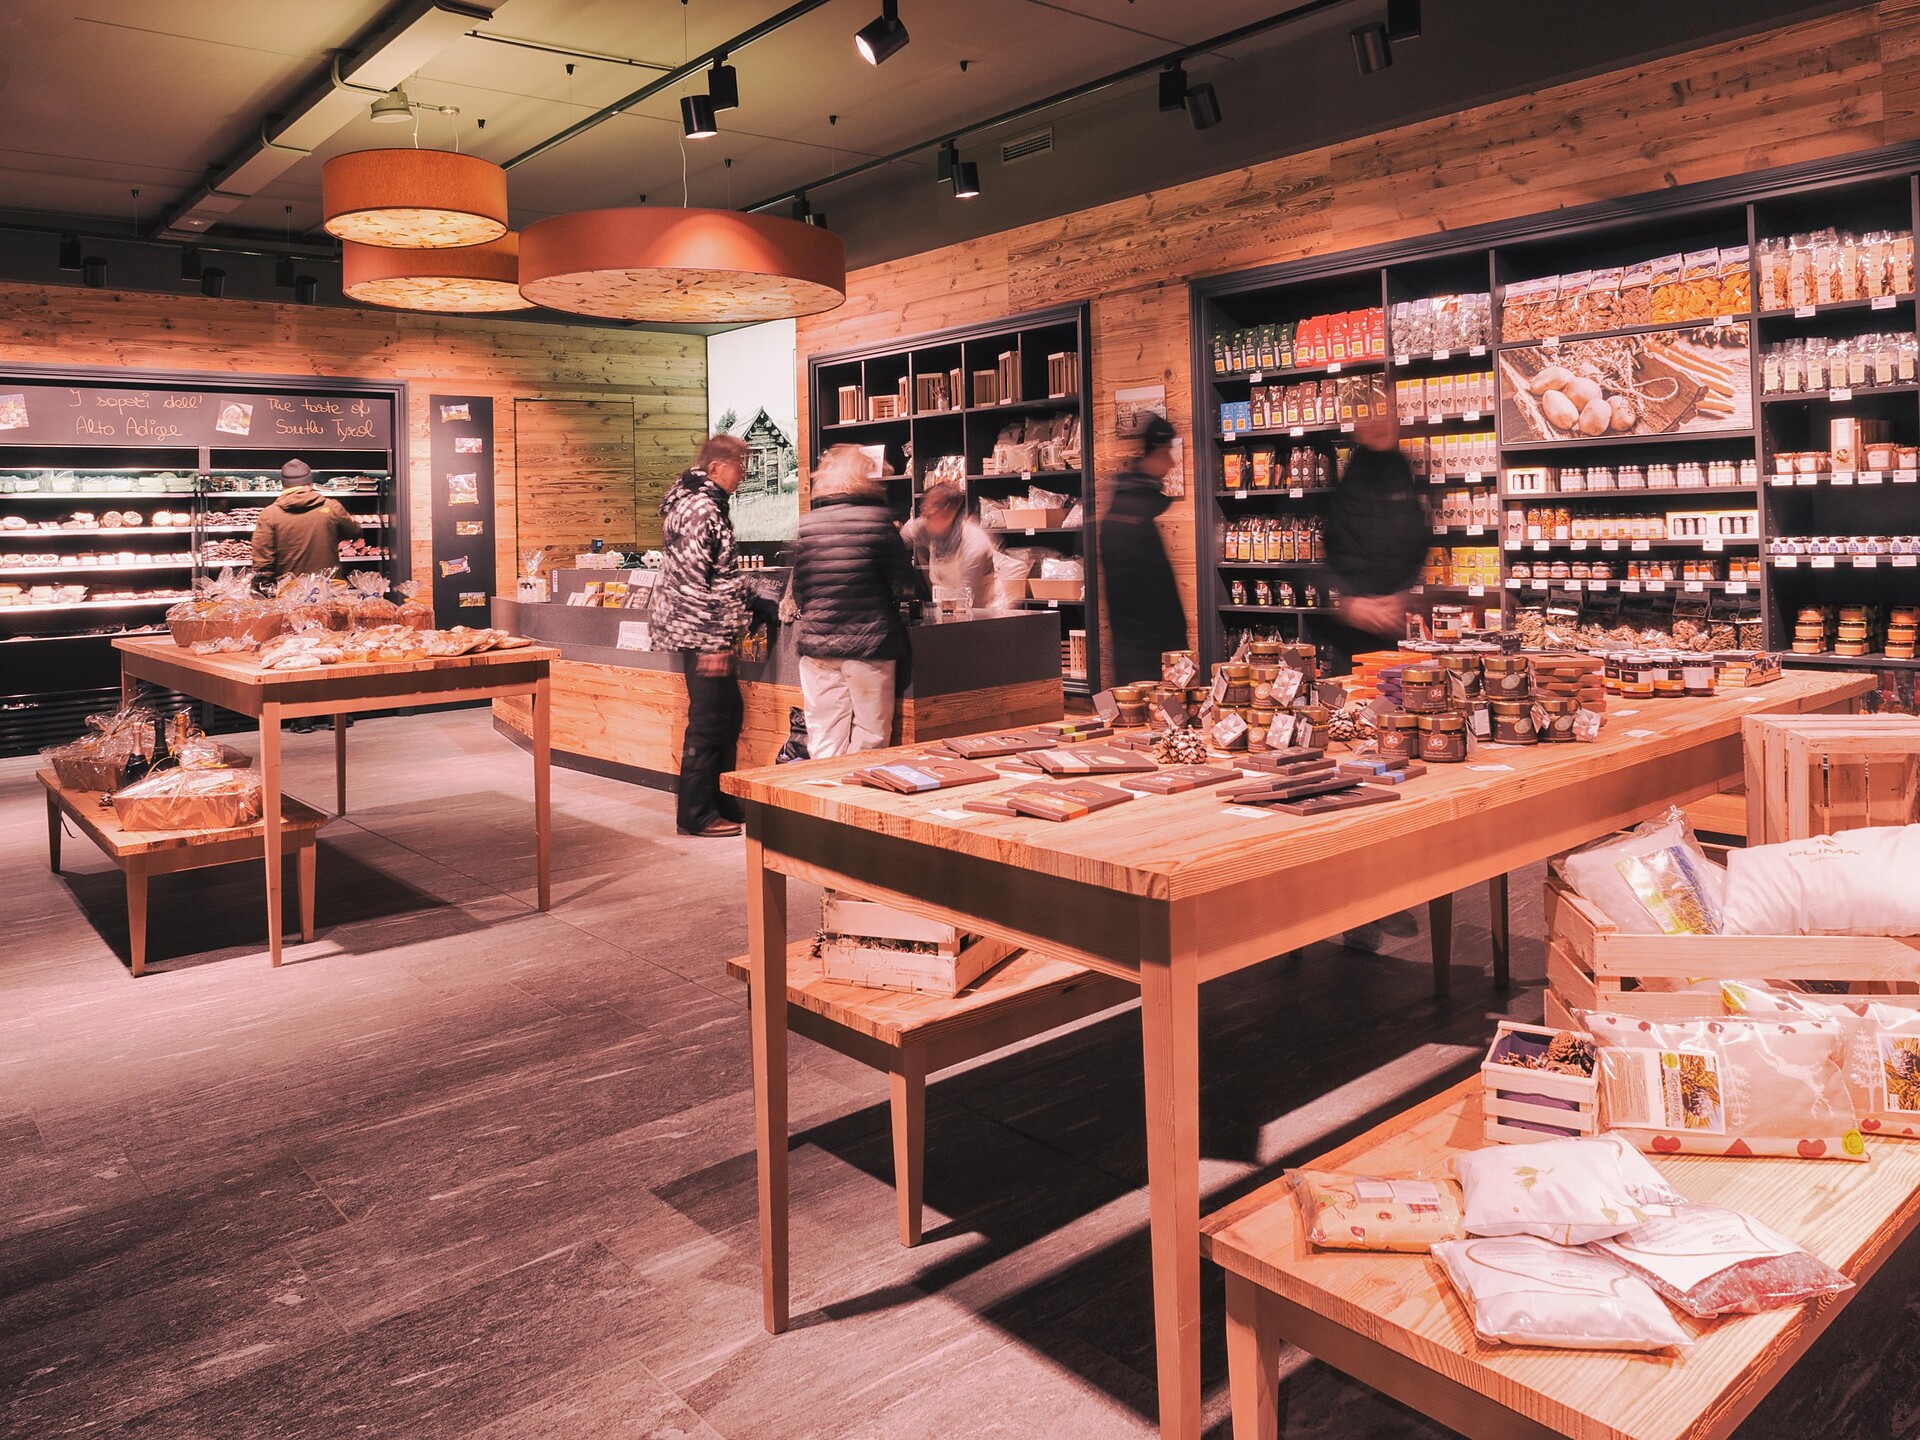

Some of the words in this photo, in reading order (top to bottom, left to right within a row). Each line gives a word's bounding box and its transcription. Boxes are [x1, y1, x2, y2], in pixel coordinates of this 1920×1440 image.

[163, 396, 203, 409] dell'
[266, 397, 295, 413] The
[302, 398, 344, 414] taste
[351, 399, 371, 417] of
[75, 416, 115, 436] Alto
[125, 416, 184, 441] Adige
[275, 418, 324, 435] South
[331, 418, 376, 442] Tyrol
[1788, 847, 1861, 857] PLIMA
